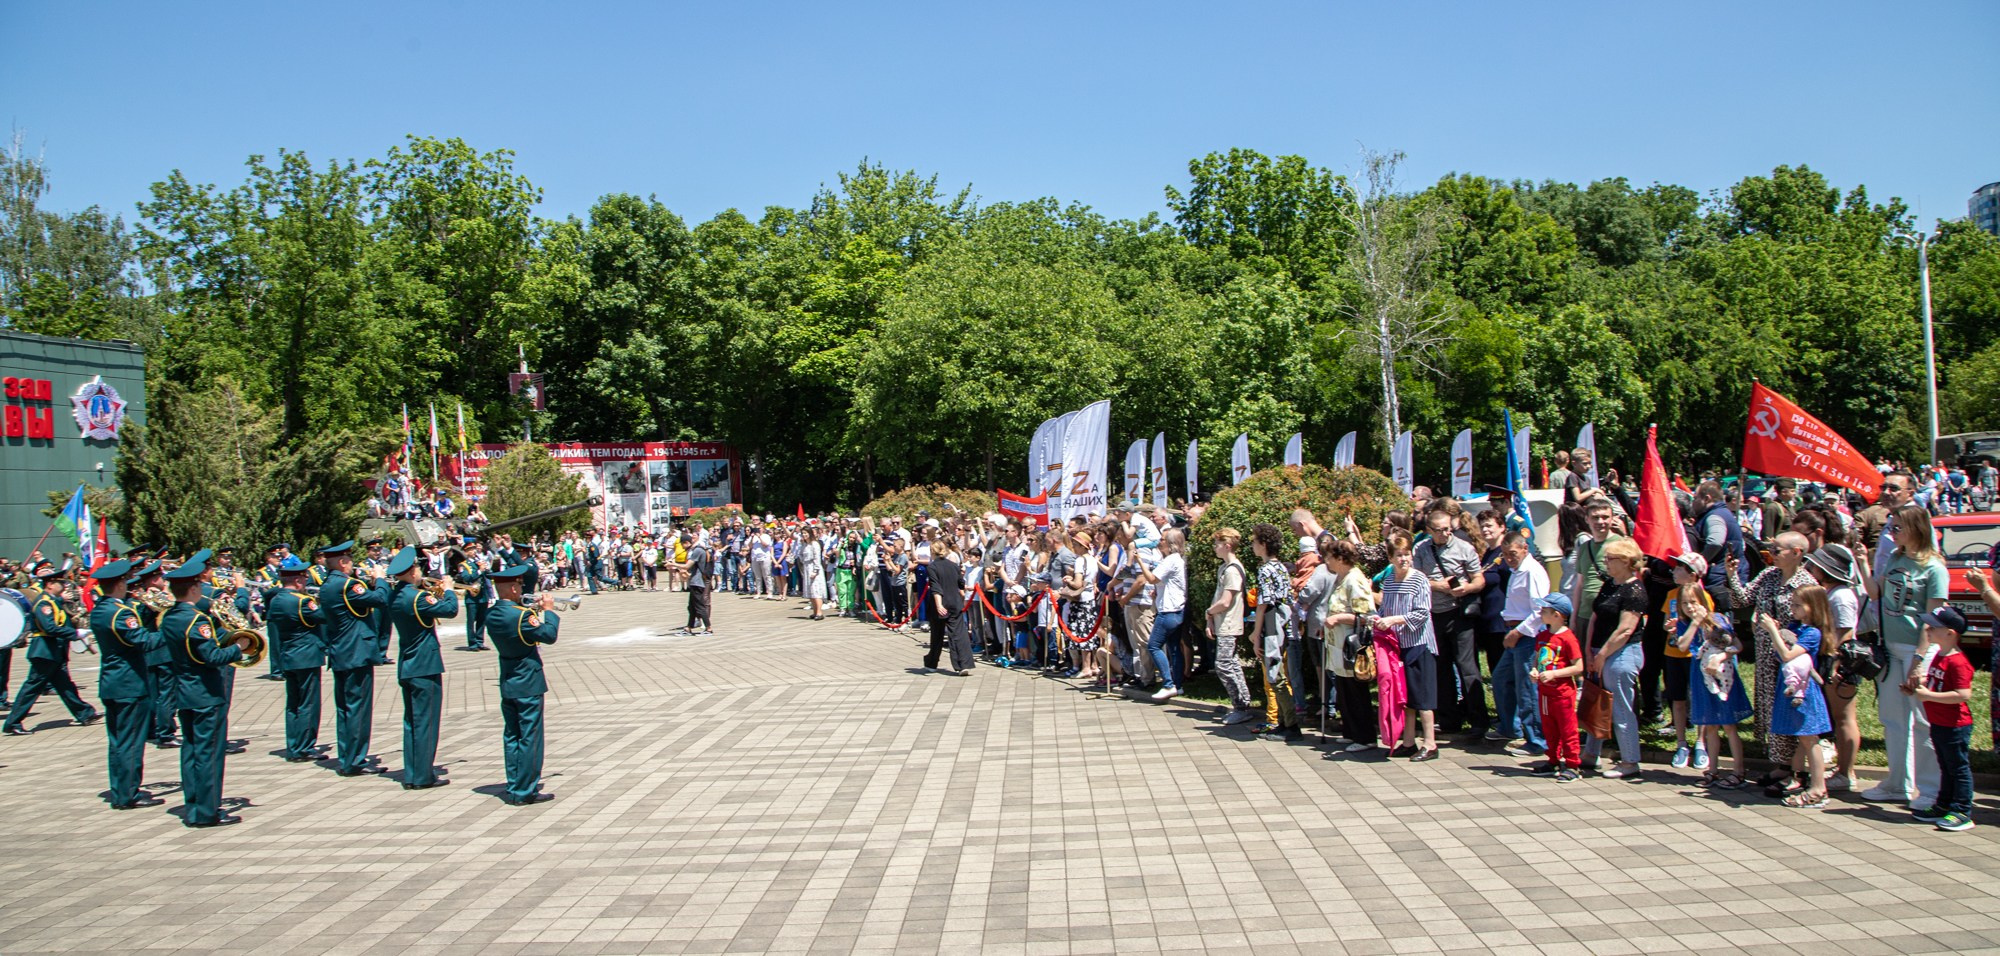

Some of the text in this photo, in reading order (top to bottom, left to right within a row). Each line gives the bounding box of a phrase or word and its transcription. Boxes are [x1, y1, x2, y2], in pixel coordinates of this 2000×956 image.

[0, 405, 54, 439] ВЫ
[549, 449, 590, 458] ЕЛИКИМ
[592, 449, 610, 457] ТЕМ
[1793, 451, 1812, 467] 79
[1456, 457, 1470, 477] Z
[1065, 496, 1103, 509] НАШИХ
